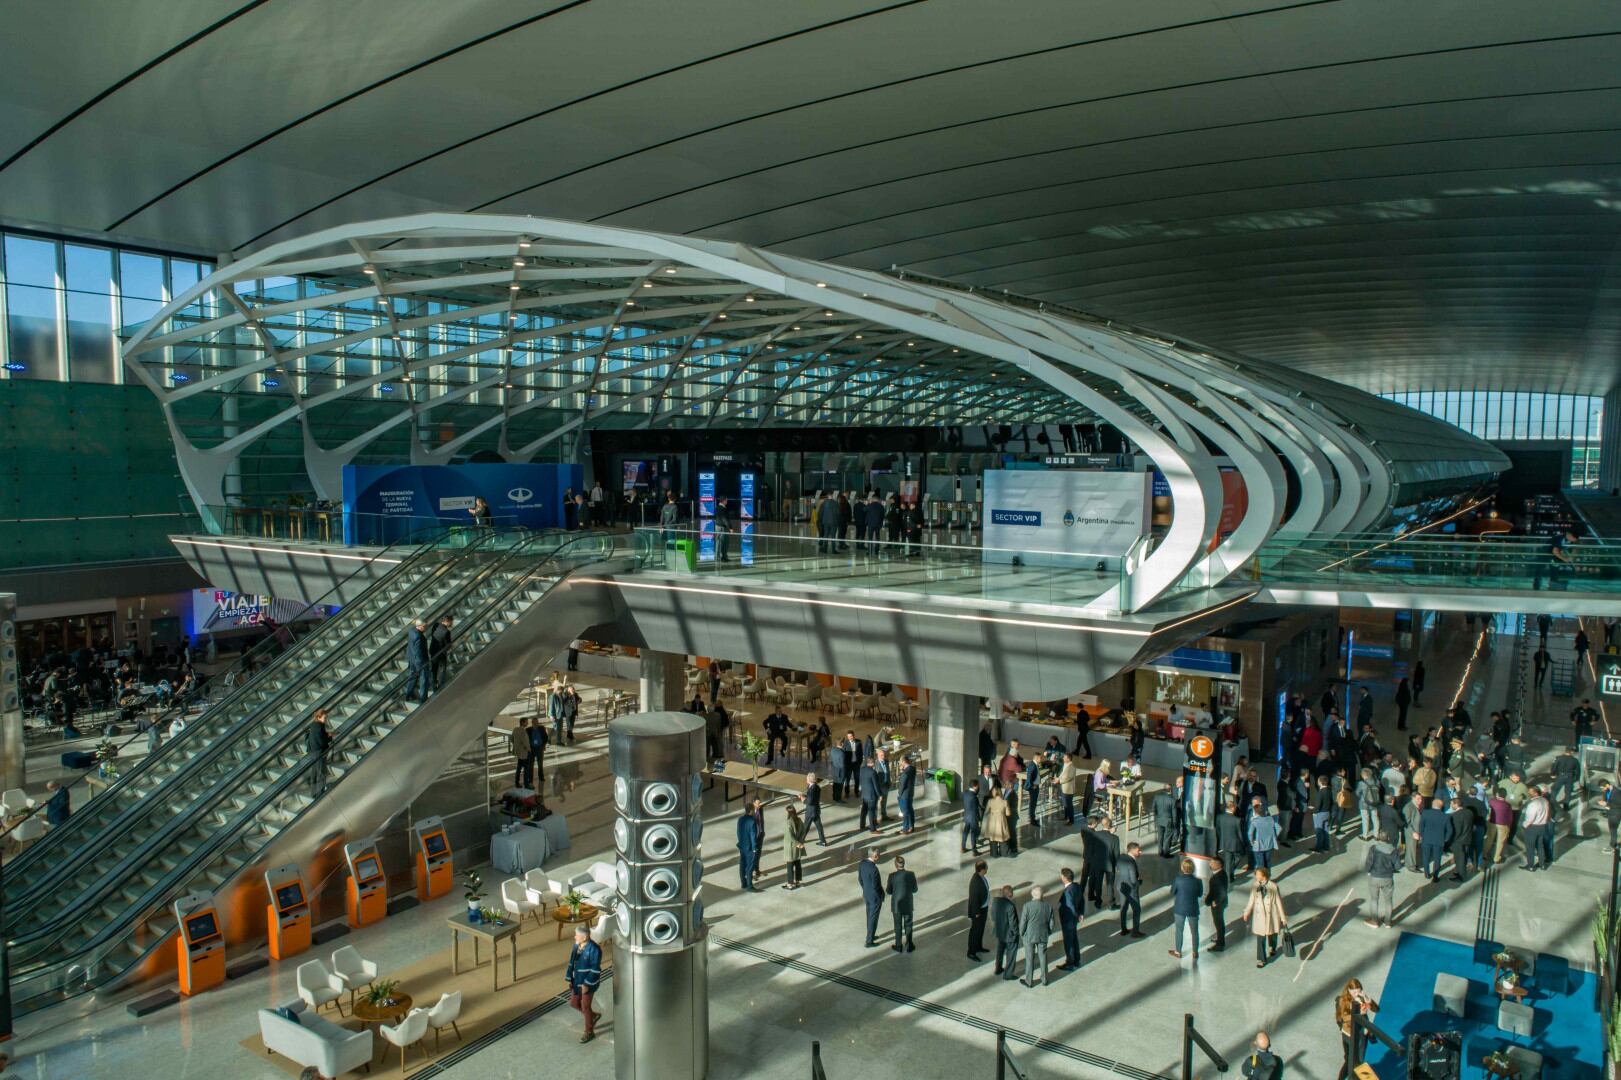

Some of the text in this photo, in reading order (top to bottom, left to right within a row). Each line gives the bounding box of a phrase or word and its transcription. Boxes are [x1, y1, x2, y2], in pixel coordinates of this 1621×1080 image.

[995, 513, 1038, 523] SECTOR VIP
[1077, 517, 1109, 525] Argentina
[217, 594, 269, 611] VIAJE
[219, 607, 258, 618] EMPIEZA
[1197, 740, 1207, 753] F
